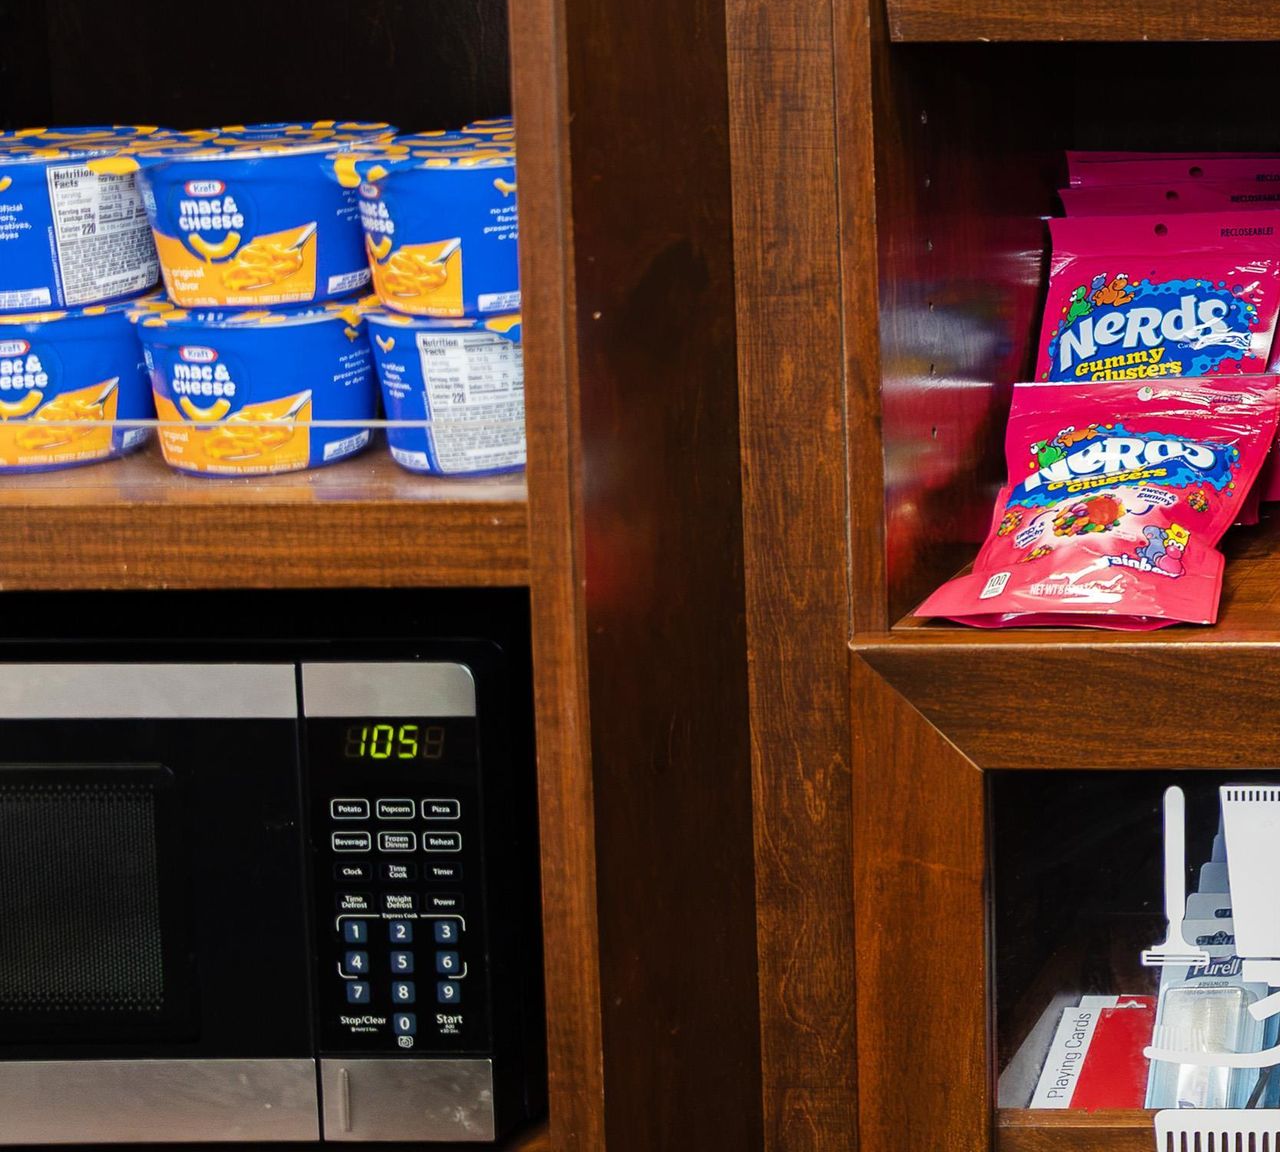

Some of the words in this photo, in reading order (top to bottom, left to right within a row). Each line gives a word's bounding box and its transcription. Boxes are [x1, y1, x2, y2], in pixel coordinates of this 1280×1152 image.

[193, 183, 216, 193] Kraft
[180, 199, 222, 216] mac
[223, 196, 238, 214] &
[1075, 346, 1166, 377] Gummy
[173, 363, 213, 381] mac
[214, 363, 230, 381] &
[1090, 359, 1182, 381] Clusters
[987, 574, 1007, 588] 100
[361, 724, 418, 759] 105
[338, 805, 362, 813] Potato
[381, 805, 411, 814] Popcorn
[431, 805, 451, 813] Pizza
[335, 838, 368, 846] Beverage
[429, 838, 455, 846] Reheat
[342, 868, 363, 876] Clock
[341, 901, 368, 909] Defrost
[386, 895, 412, 904] Weight
[386, 901, 413, 909] Defrost
[433, 898, 456, 906] Power
[352, 925, 360, 939] 1
[396, 925, 406, 939] 2
[441, 925, 451, 939] 3
[351, 955, 362, 969] 4
[397, 955, 407, 969] 5
[442, 955, 453, 969] 6
[1192, 958, 1239, 976] Purell
[353, 985, 363, 999] 7
[398, 985, 409, 999] 8
[443, 985, 454, 999] 9
[340, 1015, 387, 1025] Stop/Clear
[399, 1017, 410, 1030] 0
[436, 1014, 463, 1025] Start
[1047, 1048, 1081, 1100] Playing
[1064, 1012, 1092, 1049] Cards
